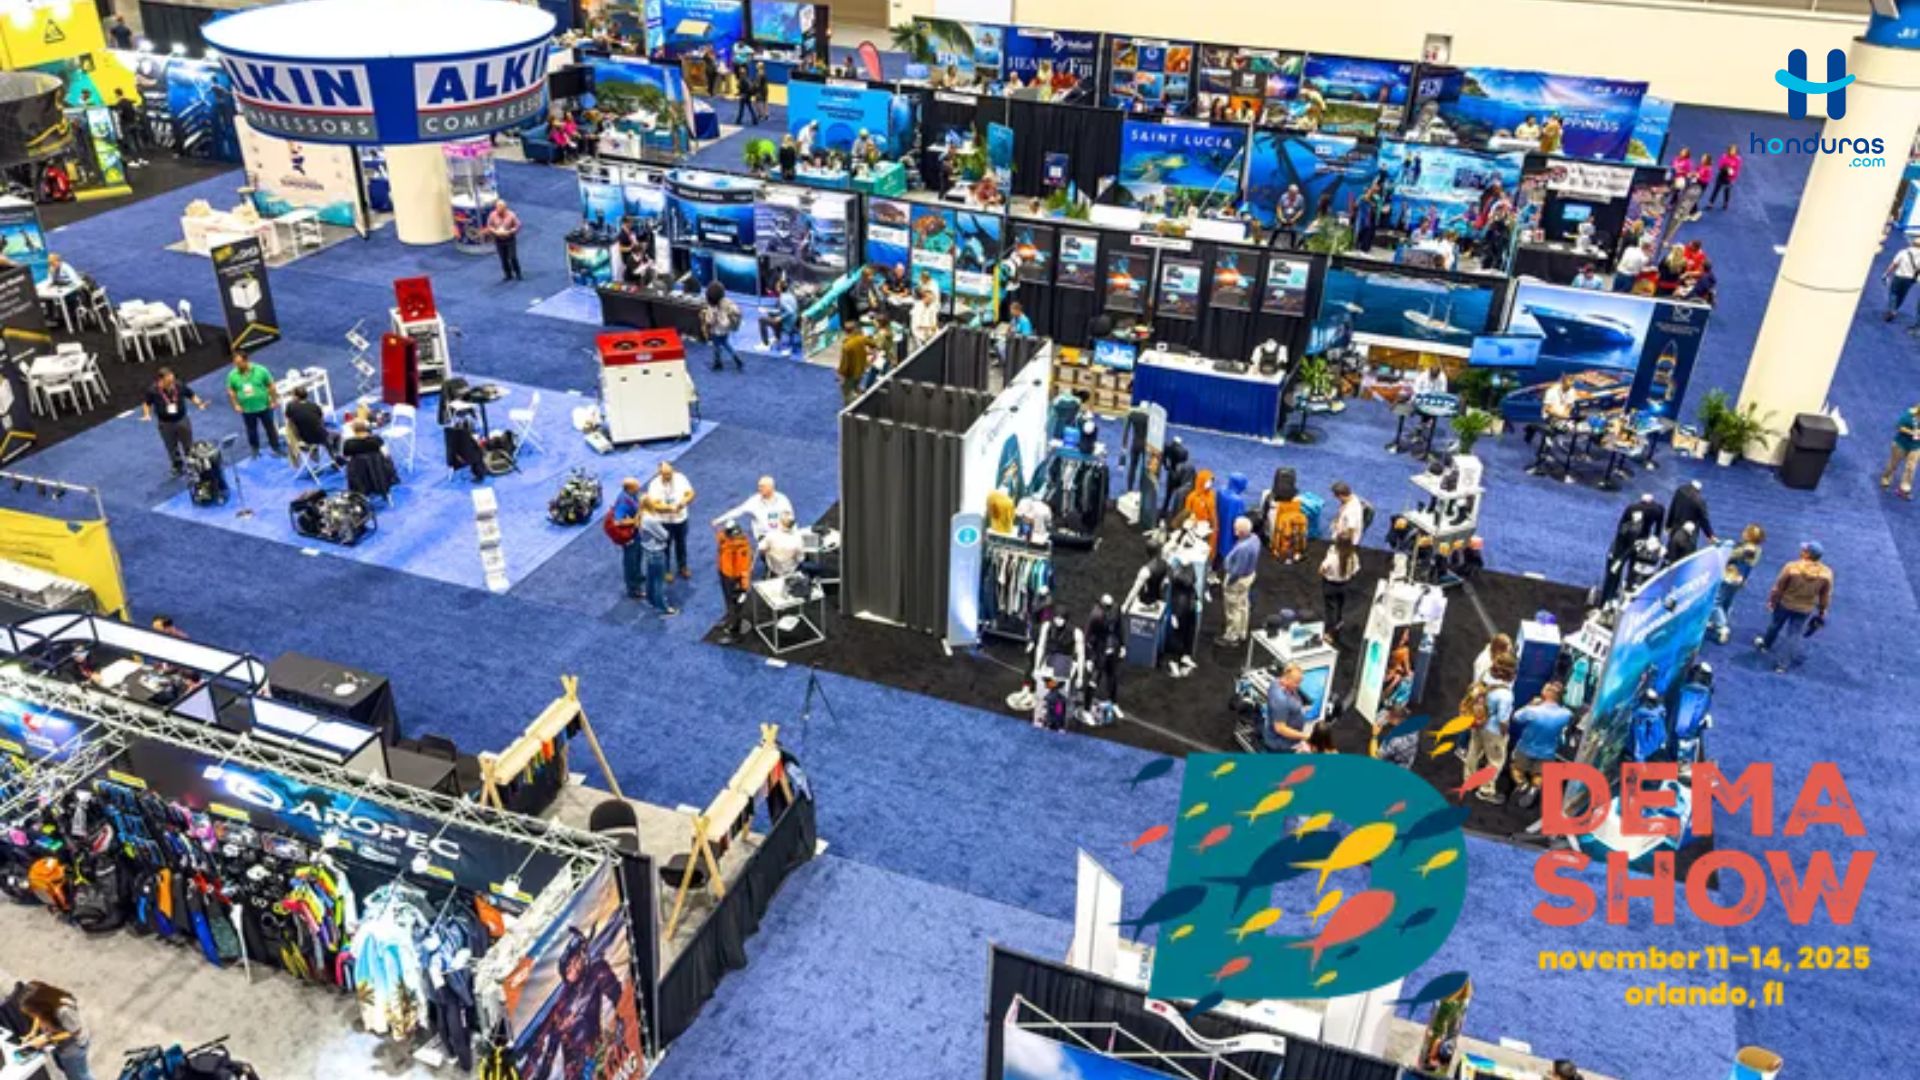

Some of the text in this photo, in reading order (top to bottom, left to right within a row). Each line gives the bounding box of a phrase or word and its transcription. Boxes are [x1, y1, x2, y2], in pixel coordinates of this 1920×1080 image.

[1008, 56, 1057, 71] HEA
[248, 109, 369, 136] MPRESSORS
[425, 90, 541, 133] COMPRESS
[1542, 115, 1620, 133] PPINESS
[1131, 128, 1233, 150] SAINT LUCIA
[289, 800, 461, 861] AROPEC
